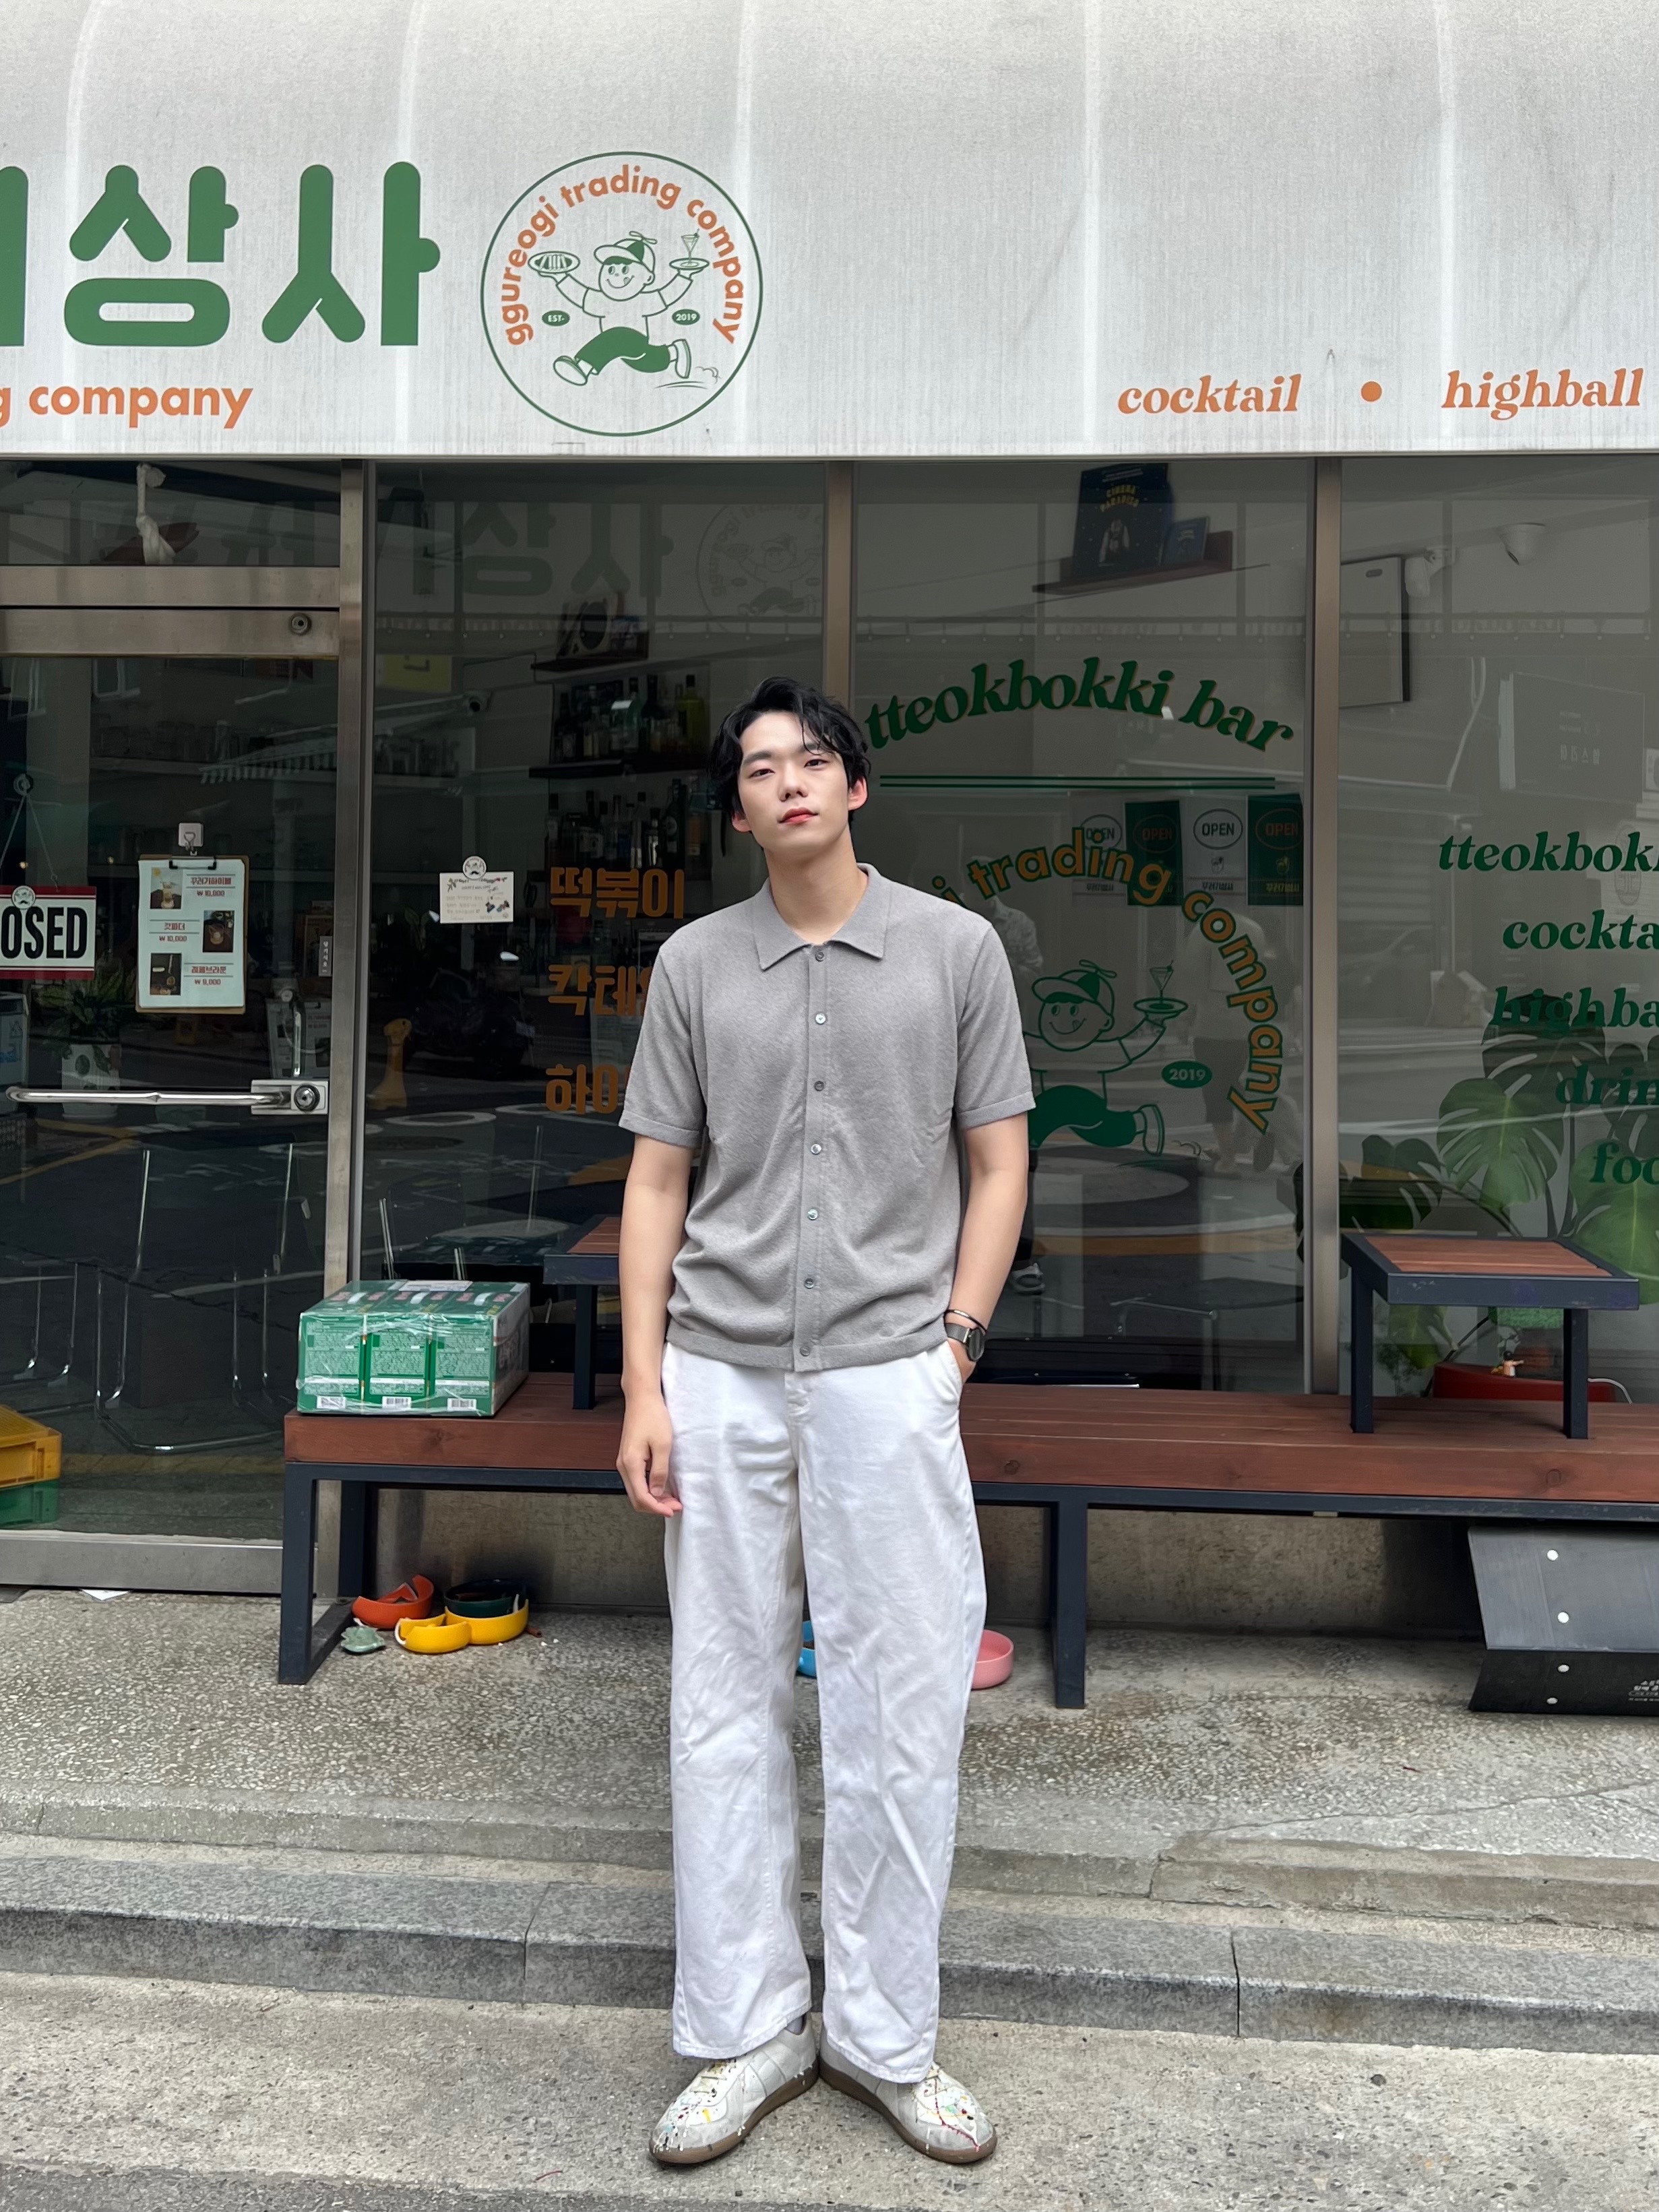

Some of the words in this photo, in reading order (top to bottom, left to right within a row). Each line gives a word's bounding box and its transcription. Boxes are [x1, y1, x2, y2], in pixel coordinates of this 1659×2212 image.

[501, 196, 559, 346] ggureogi
[560, 164, 681, 210] trading
[687, 199, 745, 344] company
[675, 313, 697, 321] 2019
[28, 385, 254, 429] company
[1117, 373, 1302, 414] cocktail
[1441, 367, 1645, 421] highball
[864, 656, 1176, 749] tteokbokki
[1178, 679, 1294, 752] bar
[1141, 827, 1172, 841] OPEN
[1201, 823, 1234, 837] OPEN
[1265, 823, 1299, 837] OPEN
[1438, 830, 1659, 873] tteokbok
[549, 866, 686, 920] 떡볶이
[1, 906, 88, 959] OSED
[1502, 908, 1659, 950] cockta
[967, 825, 1172, 906] trading
[1181, 890, 1283, 1135] company
[1488, 986, 1659, 1040] highba
[1168, 1068, 1206, 1082] 2019
